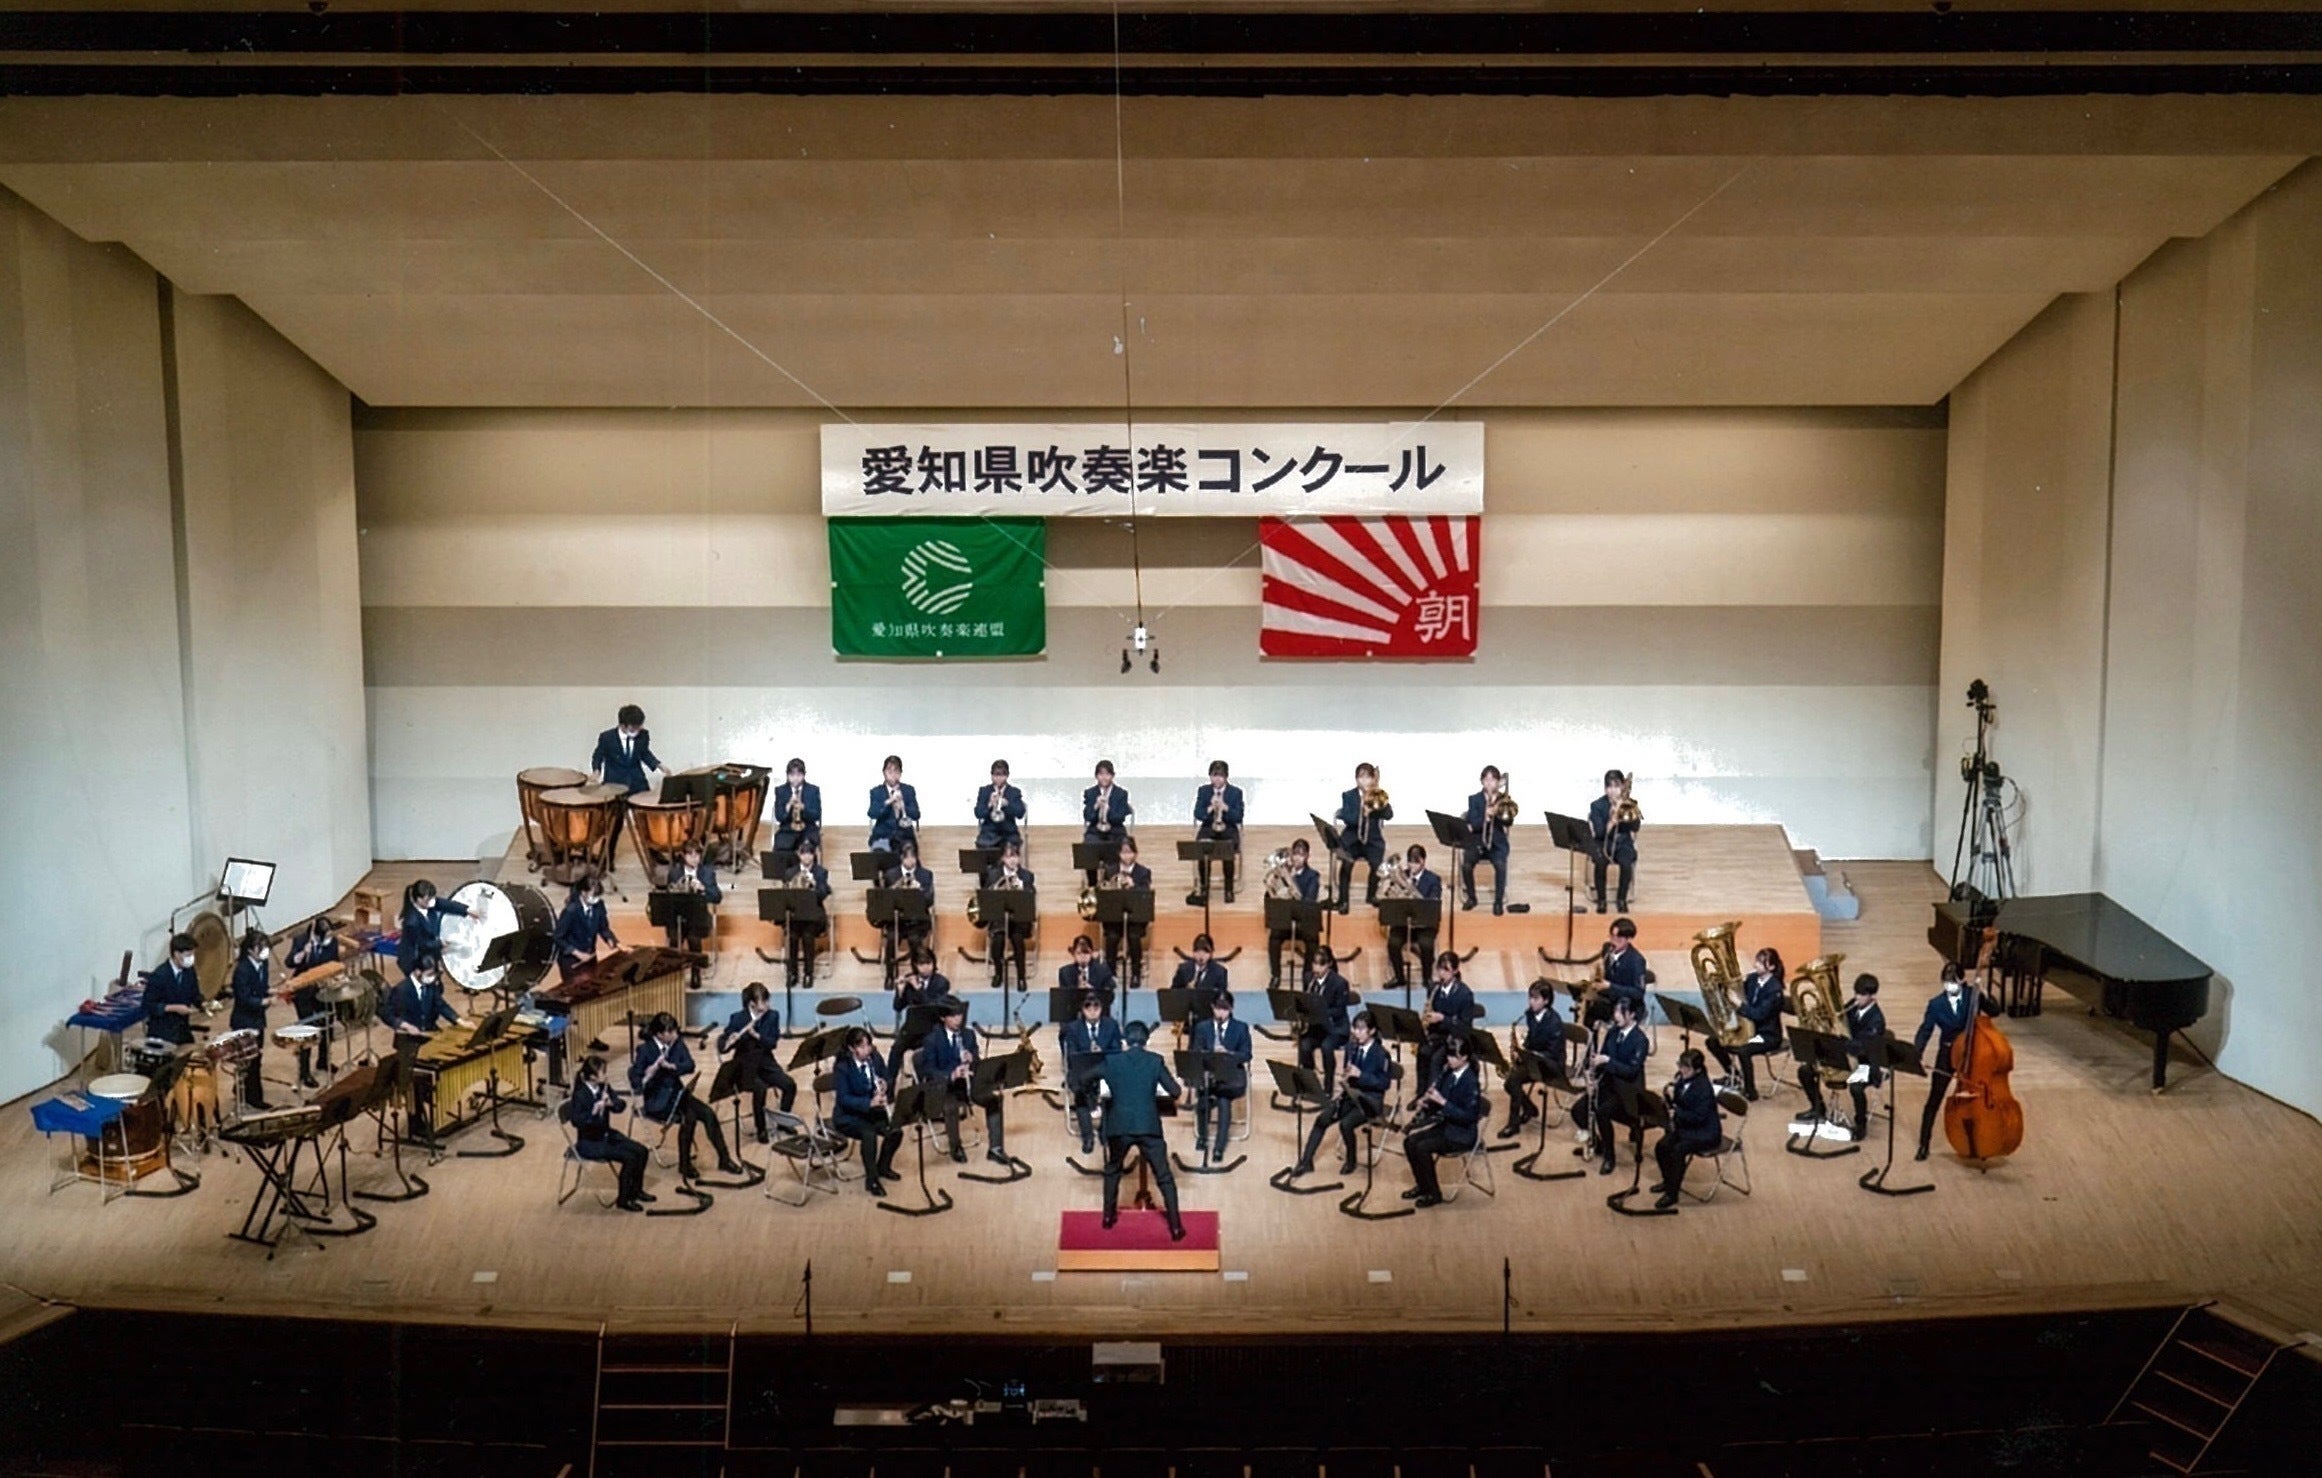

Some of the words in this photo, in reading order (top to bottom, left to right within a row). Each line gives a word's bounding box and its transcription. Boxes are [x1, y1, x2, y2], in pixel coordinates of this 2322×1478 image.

[862, 445, 1446, 495] 愛知県吹奏楽コンクール
[1414, 590, 1470, 644] 朝
